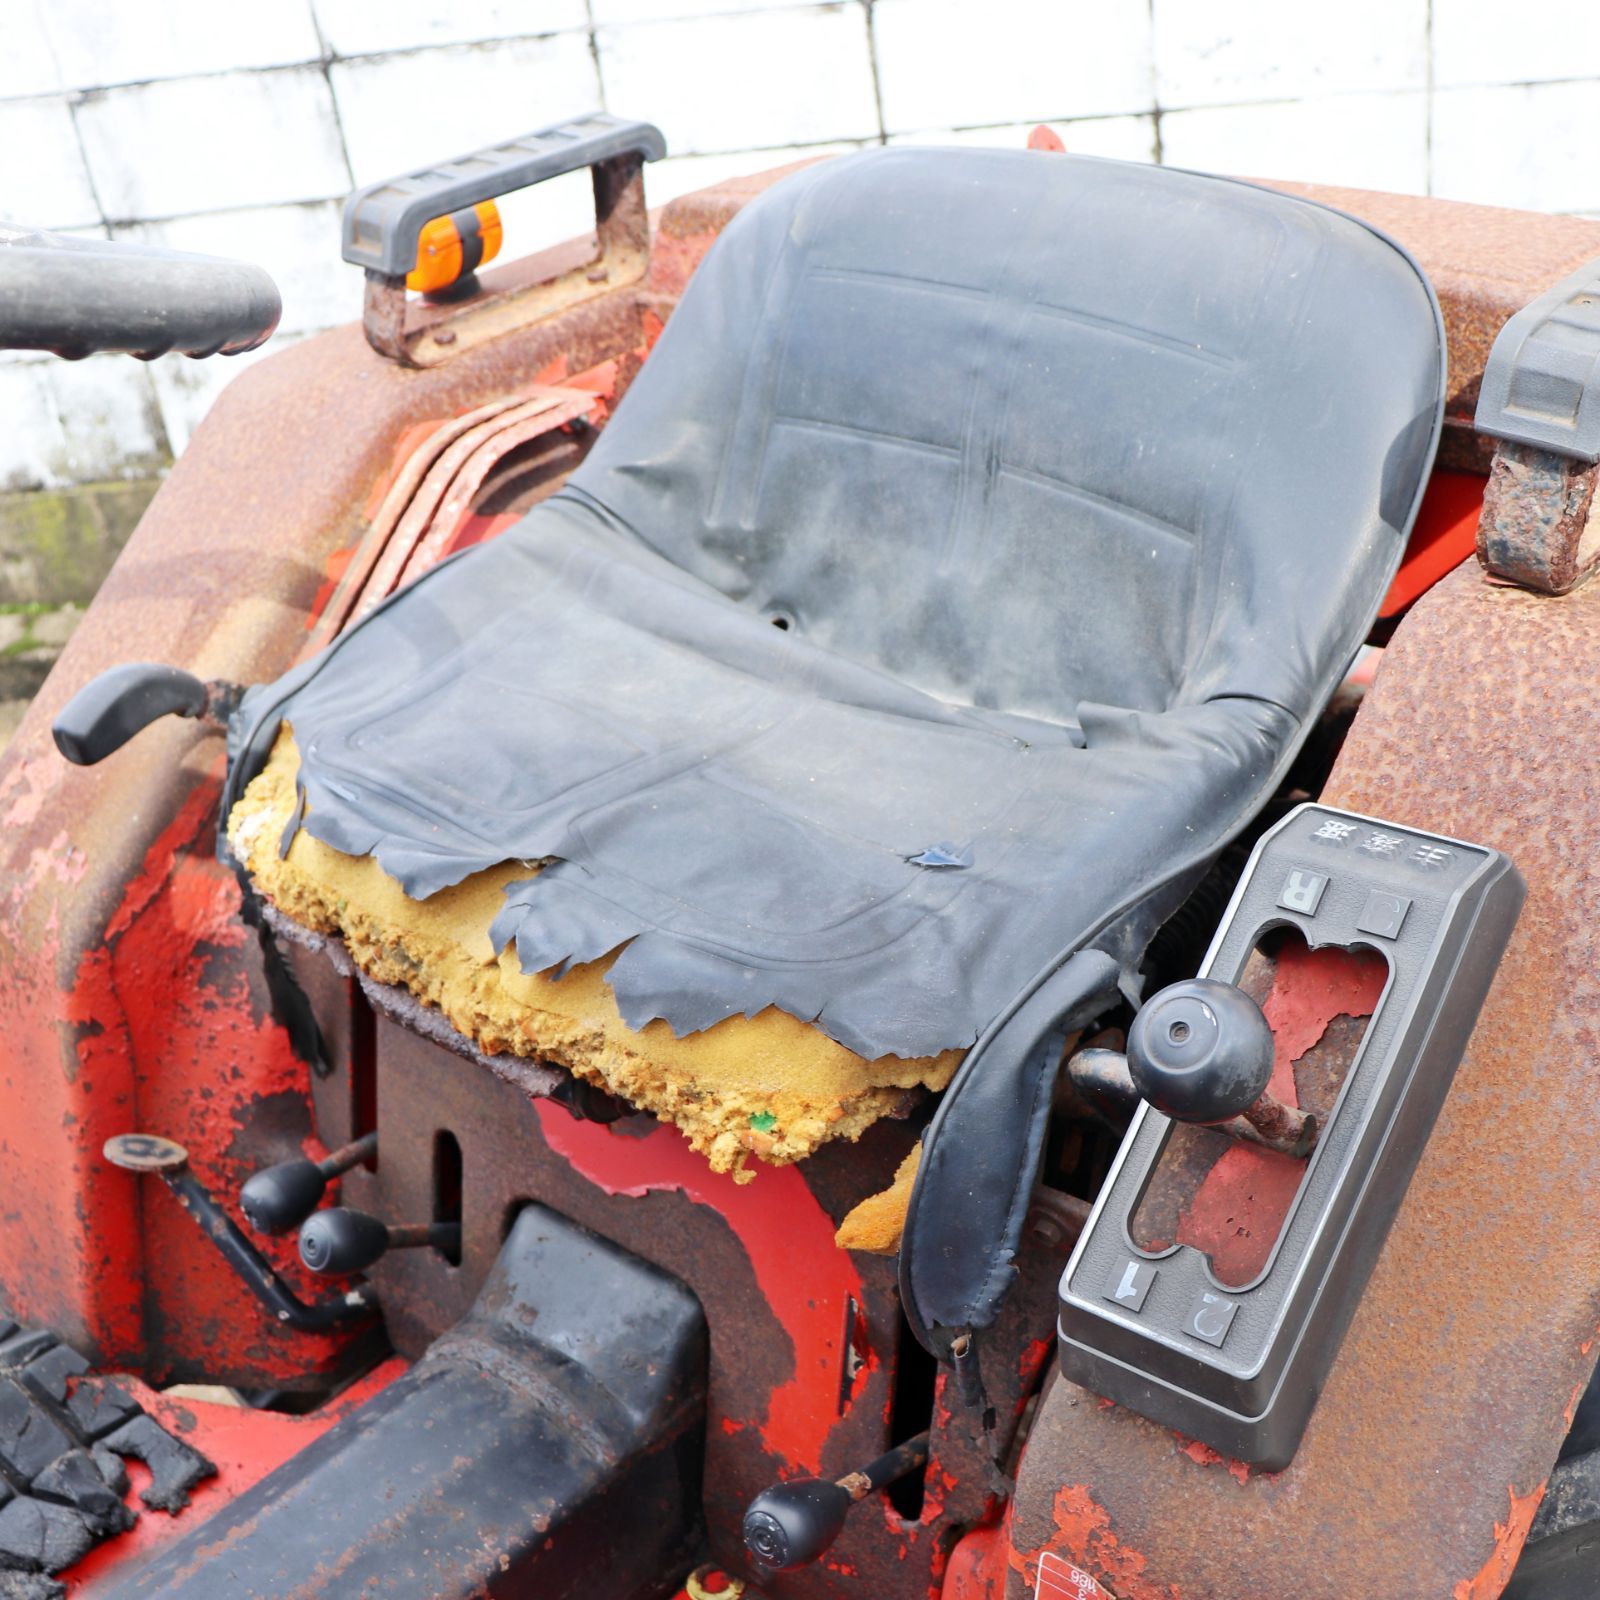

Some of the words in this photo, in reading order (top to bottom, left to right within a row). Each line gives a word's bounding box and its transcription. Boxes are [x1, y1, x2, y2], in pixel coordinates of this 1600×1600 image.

[1283, 871, 1322, 912] R
[1114, 1260, 1140, 1300] 1
[1193, 1292, 1233, 1337] 2
